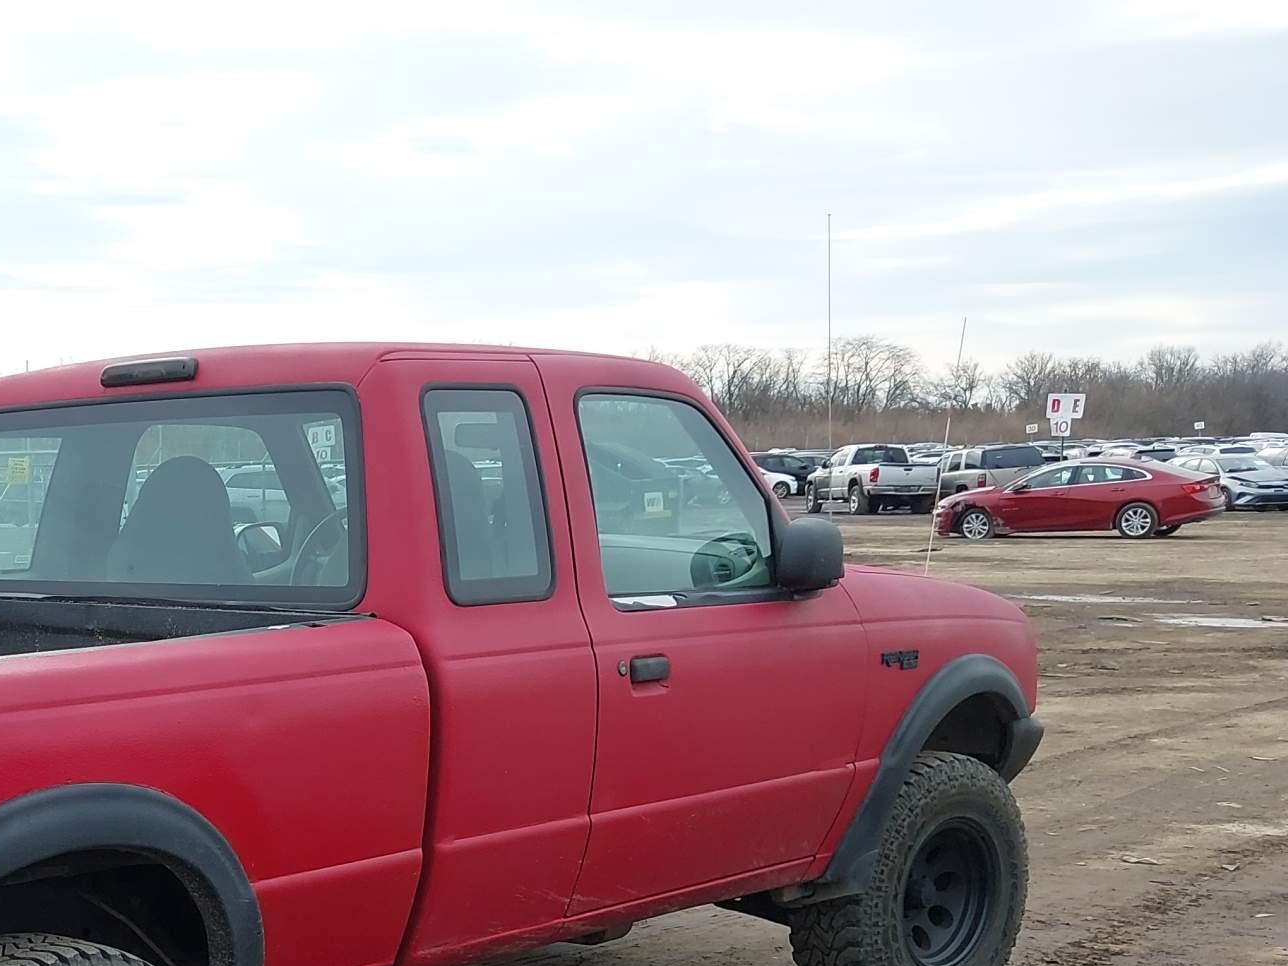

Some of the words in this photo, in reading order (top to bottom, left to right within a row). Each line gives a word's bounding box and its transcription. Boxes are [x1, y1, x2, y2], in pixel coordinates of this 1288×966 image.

[1051, 398, 1061, 413] D
[1072, 398, 1081, 413] E
[1053, 420, 1069, 433] 10
[325, 430, 332, 442] C
